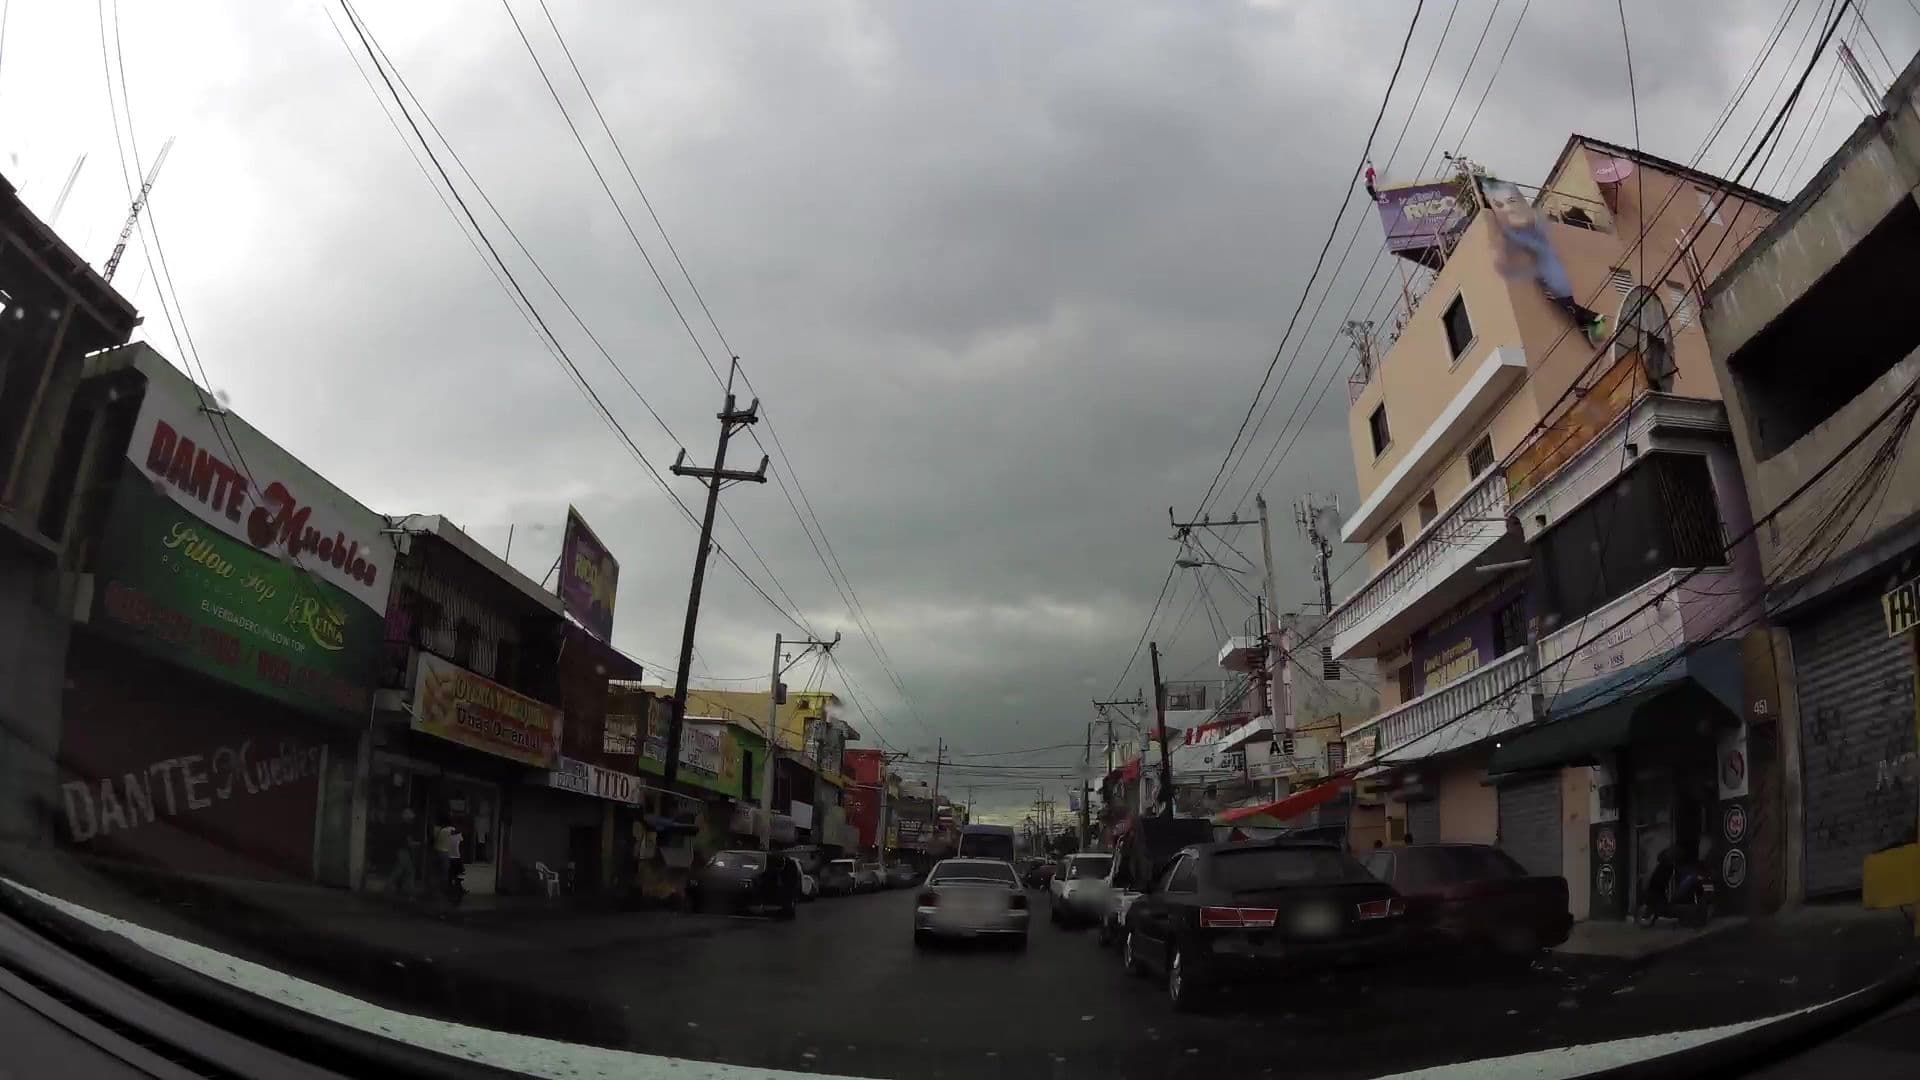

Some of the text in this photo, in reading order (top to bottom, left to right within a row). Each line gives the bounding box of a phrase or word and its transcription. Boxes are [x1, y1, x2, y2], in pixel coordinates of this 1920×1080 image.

[147, 419, 249, 524] DANTE
[247, 481, 377, 587] Muebles
[1753, 699, 1768, 716] 451
[62, 754, 212, 843] DANTE
